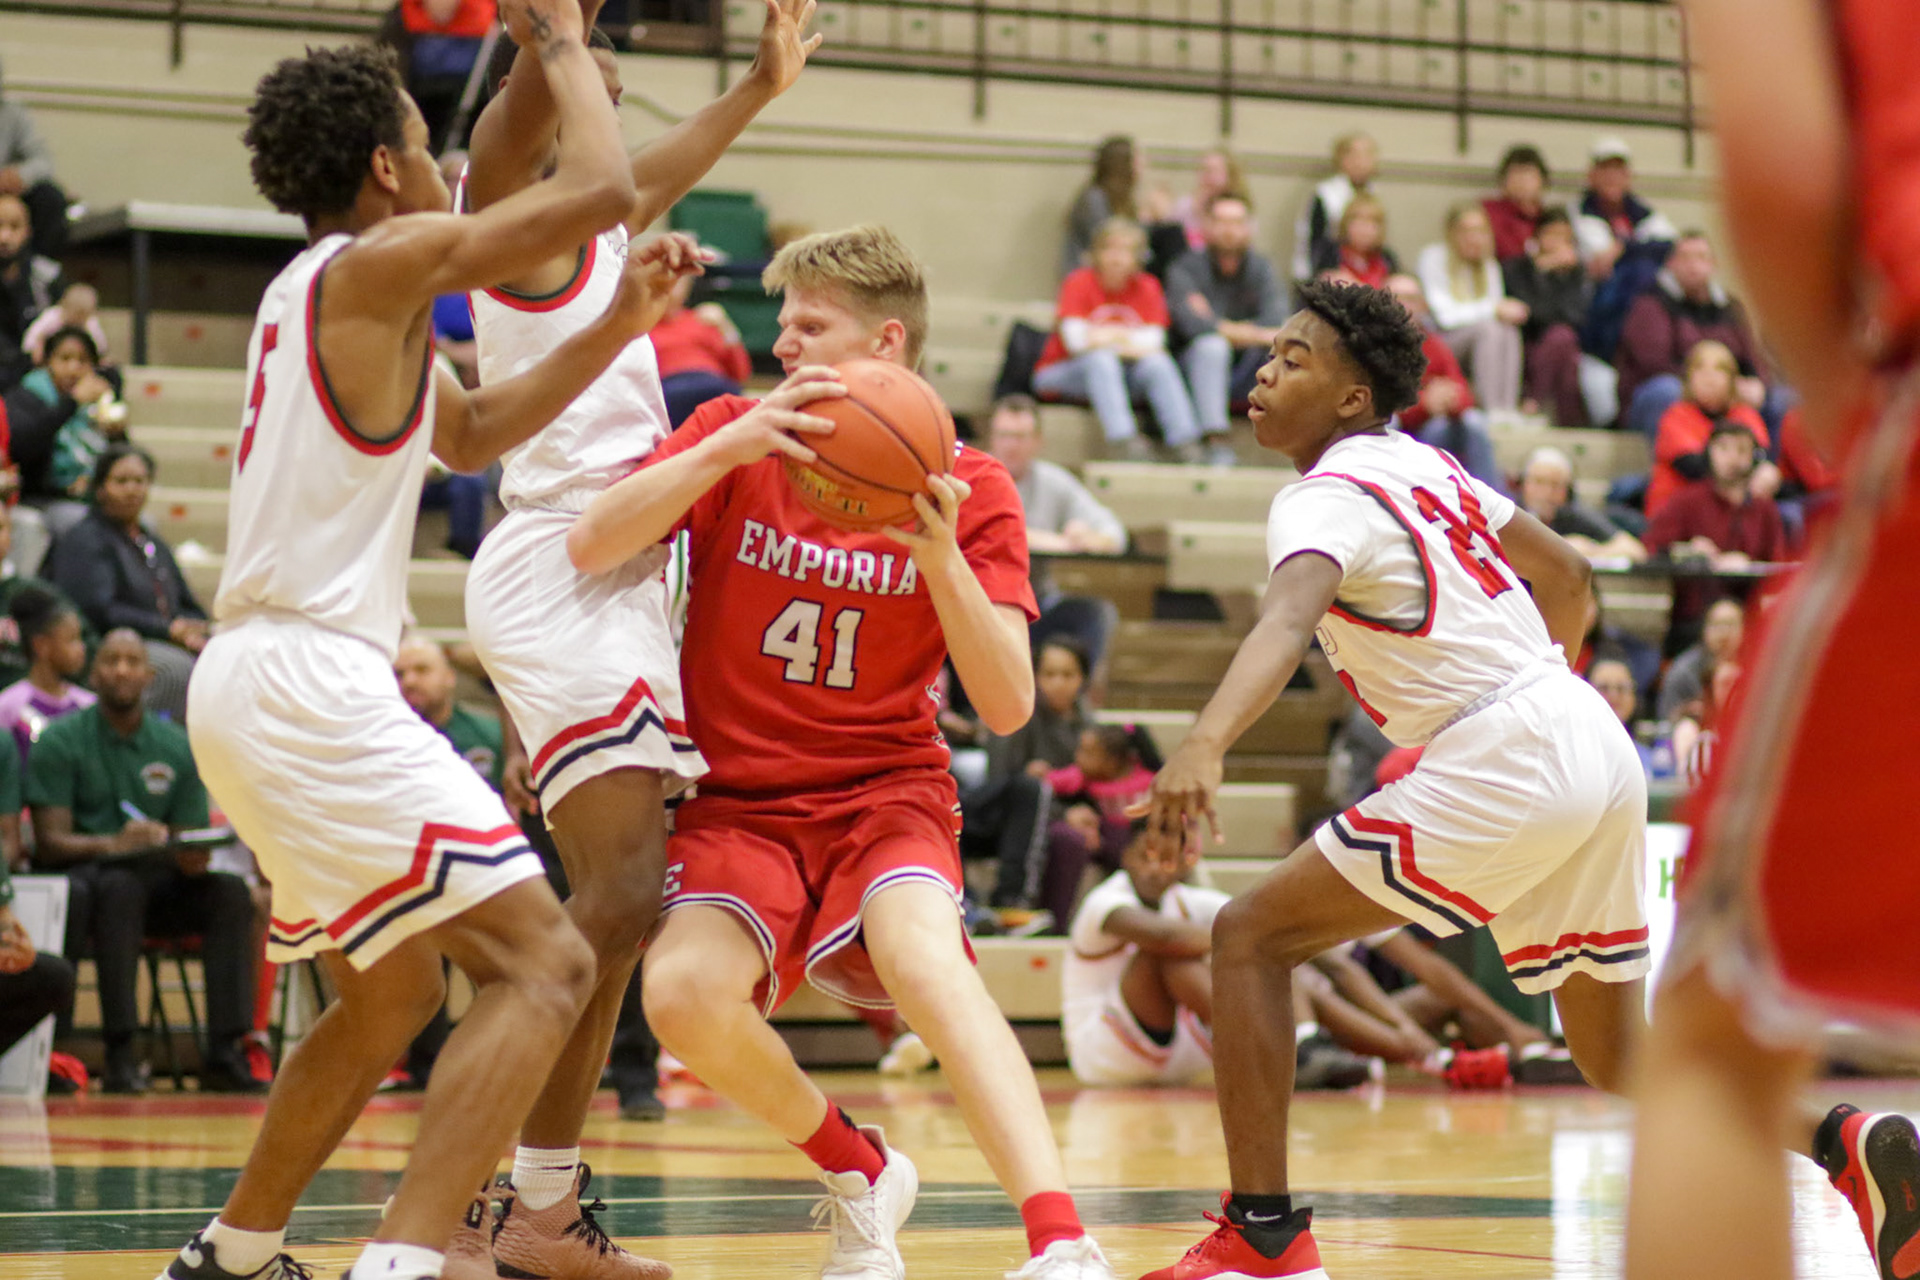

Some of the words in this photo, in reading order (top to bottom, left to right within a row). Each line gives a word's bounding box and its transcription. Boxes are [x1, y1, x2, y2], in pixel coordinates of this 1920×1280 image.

[736, 518, 918, 596] EMPORIA
[760, 597, 864, 690] 41
[662, 862, 684, 897] E
